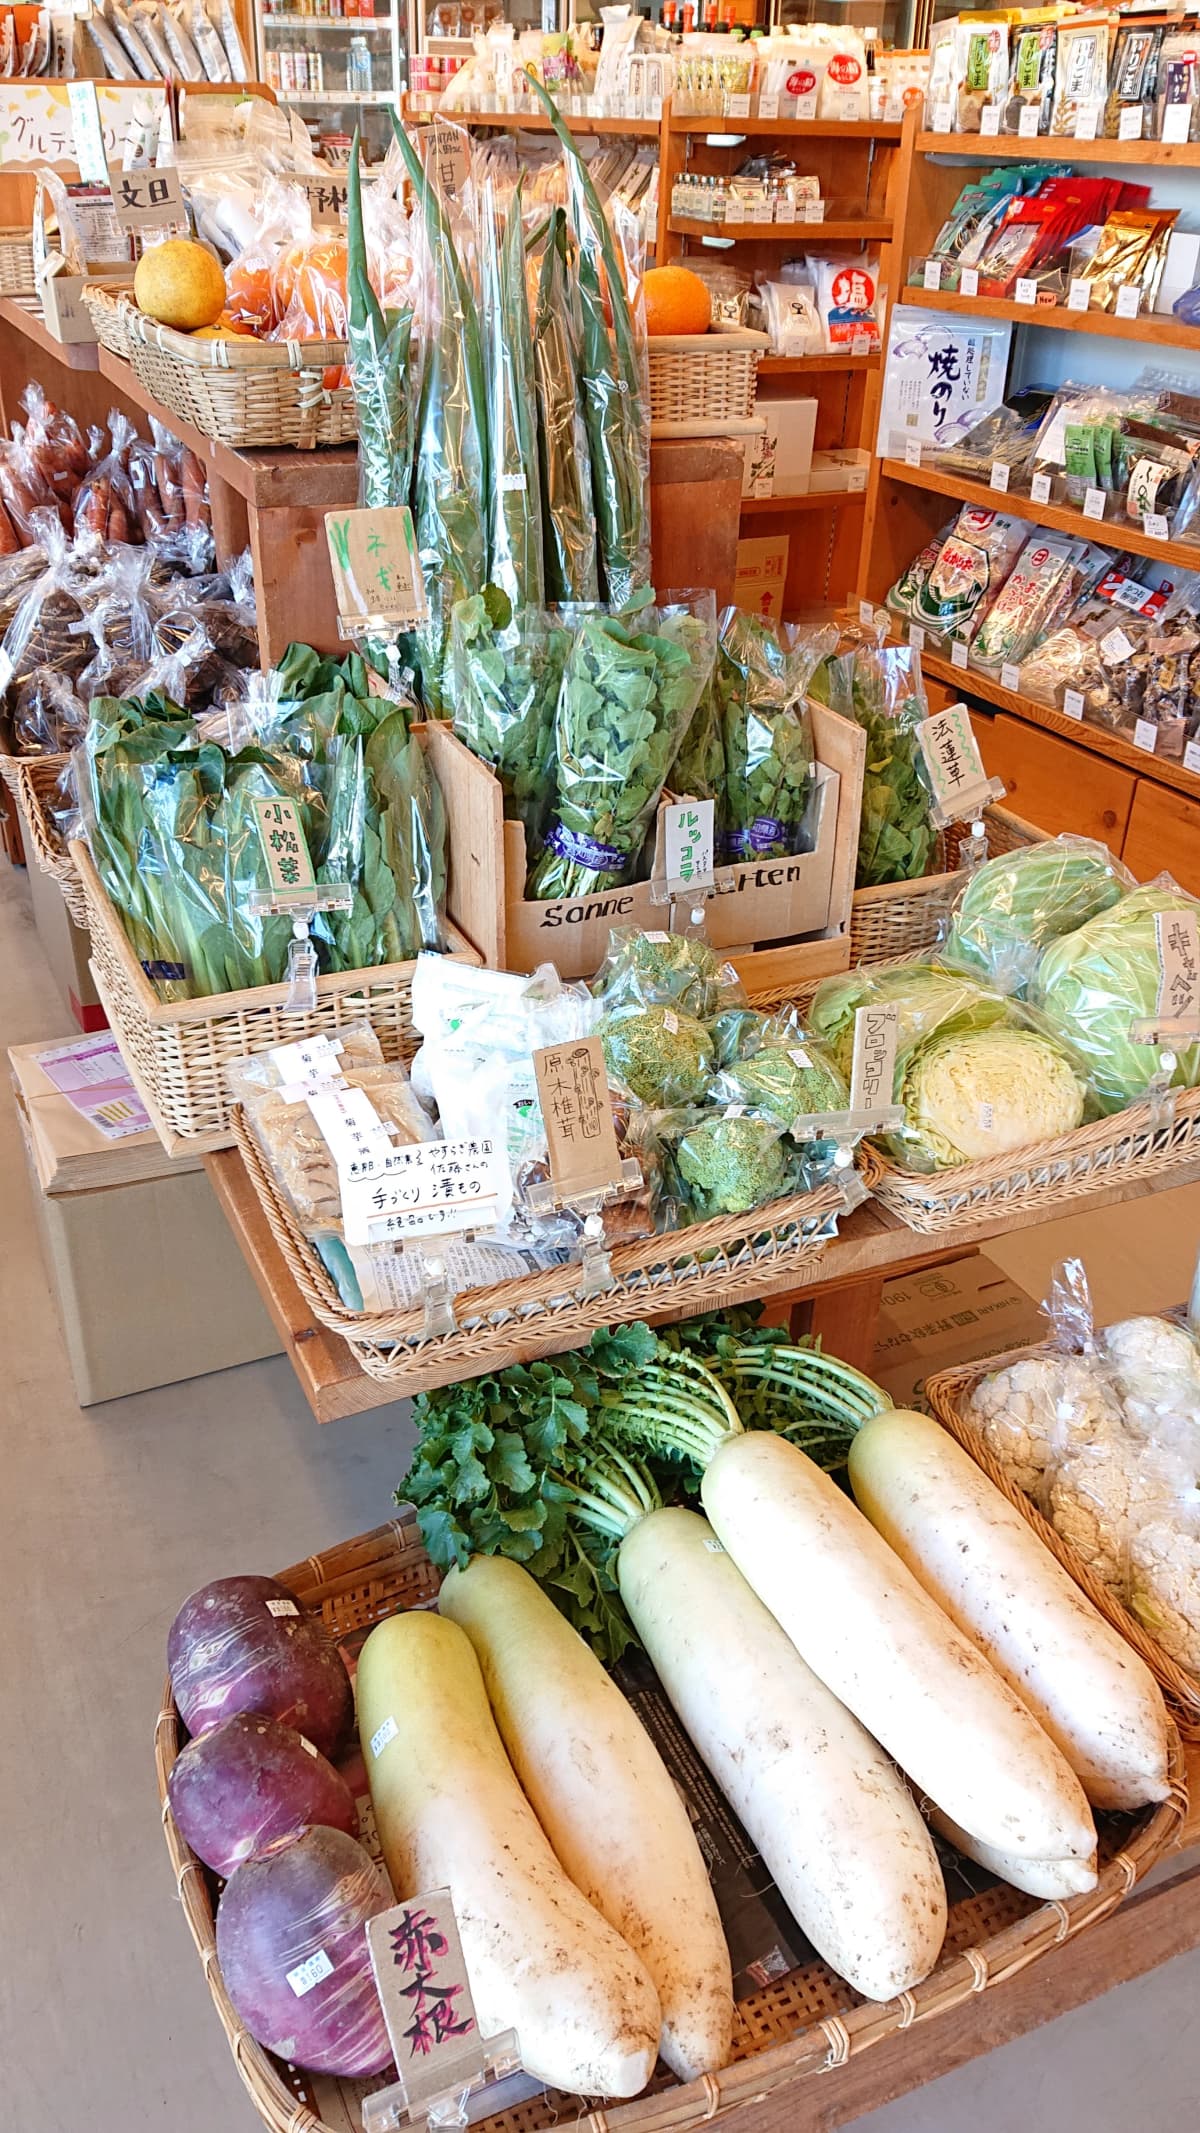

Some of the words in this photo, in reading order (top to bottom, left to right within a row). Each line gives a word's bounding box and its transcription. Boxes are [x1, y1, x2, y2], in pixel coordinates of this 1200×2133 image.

[117, 179, 176, 208] 文旦
[836, 270, 869, 312] 塩
[1039, 295, 1055, 303] New!
[926, 343, 961, 428] 焼のり
[367, 528, 396, 592] ネギ
[931, 718, 966, 788] 法蓮草
[263, 803, 301, 885] 小松菜
[540, 895, 634, 928] Sonne
[737, 865, 801, 892] rten
[862, 1013, 897, 1109] ブロッコリー
[544, 1052, 577, 1143] 原木椎茸
[371, 1186, 421, 1210] 手づくり
[431, 1177, 481, 1200] 漬もの
[388, 1908, 477, 2059] 赤大根
